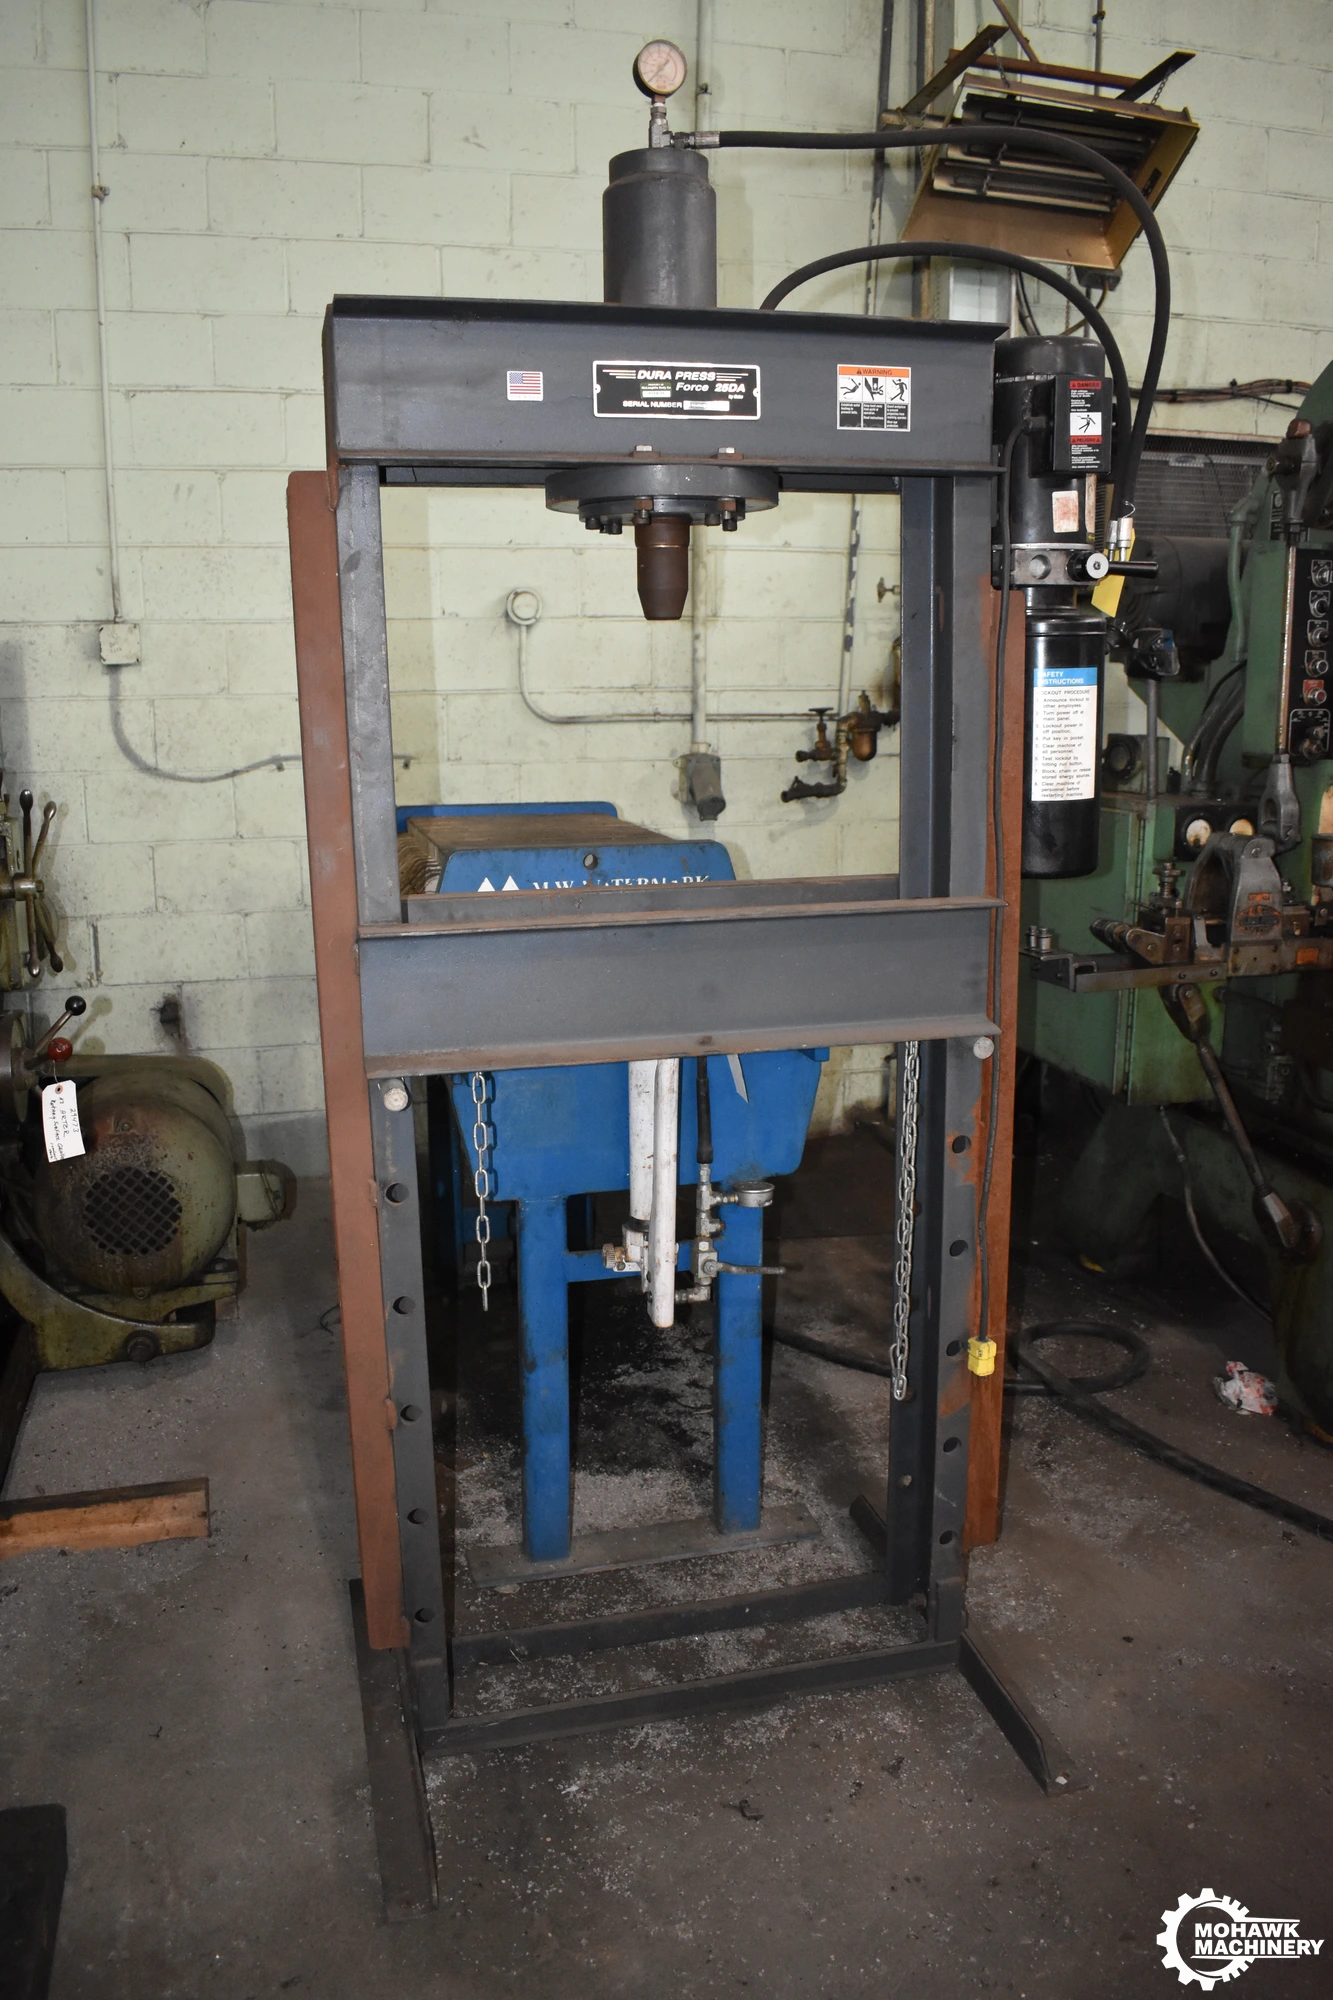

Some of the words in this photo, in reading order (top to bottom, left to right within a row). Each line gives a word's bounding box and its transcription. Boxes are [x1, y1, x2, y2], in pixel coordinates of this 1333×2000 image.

[637, 369, 672, 380] DURA
[675, 371, 716, 382] PRESS
[862, 368, 893, 376] WARNING
[675, 381, 710, 392] Force
[622, 400, 650, 408] SERIAL
[650, 401, 683, 409] NUMBER
